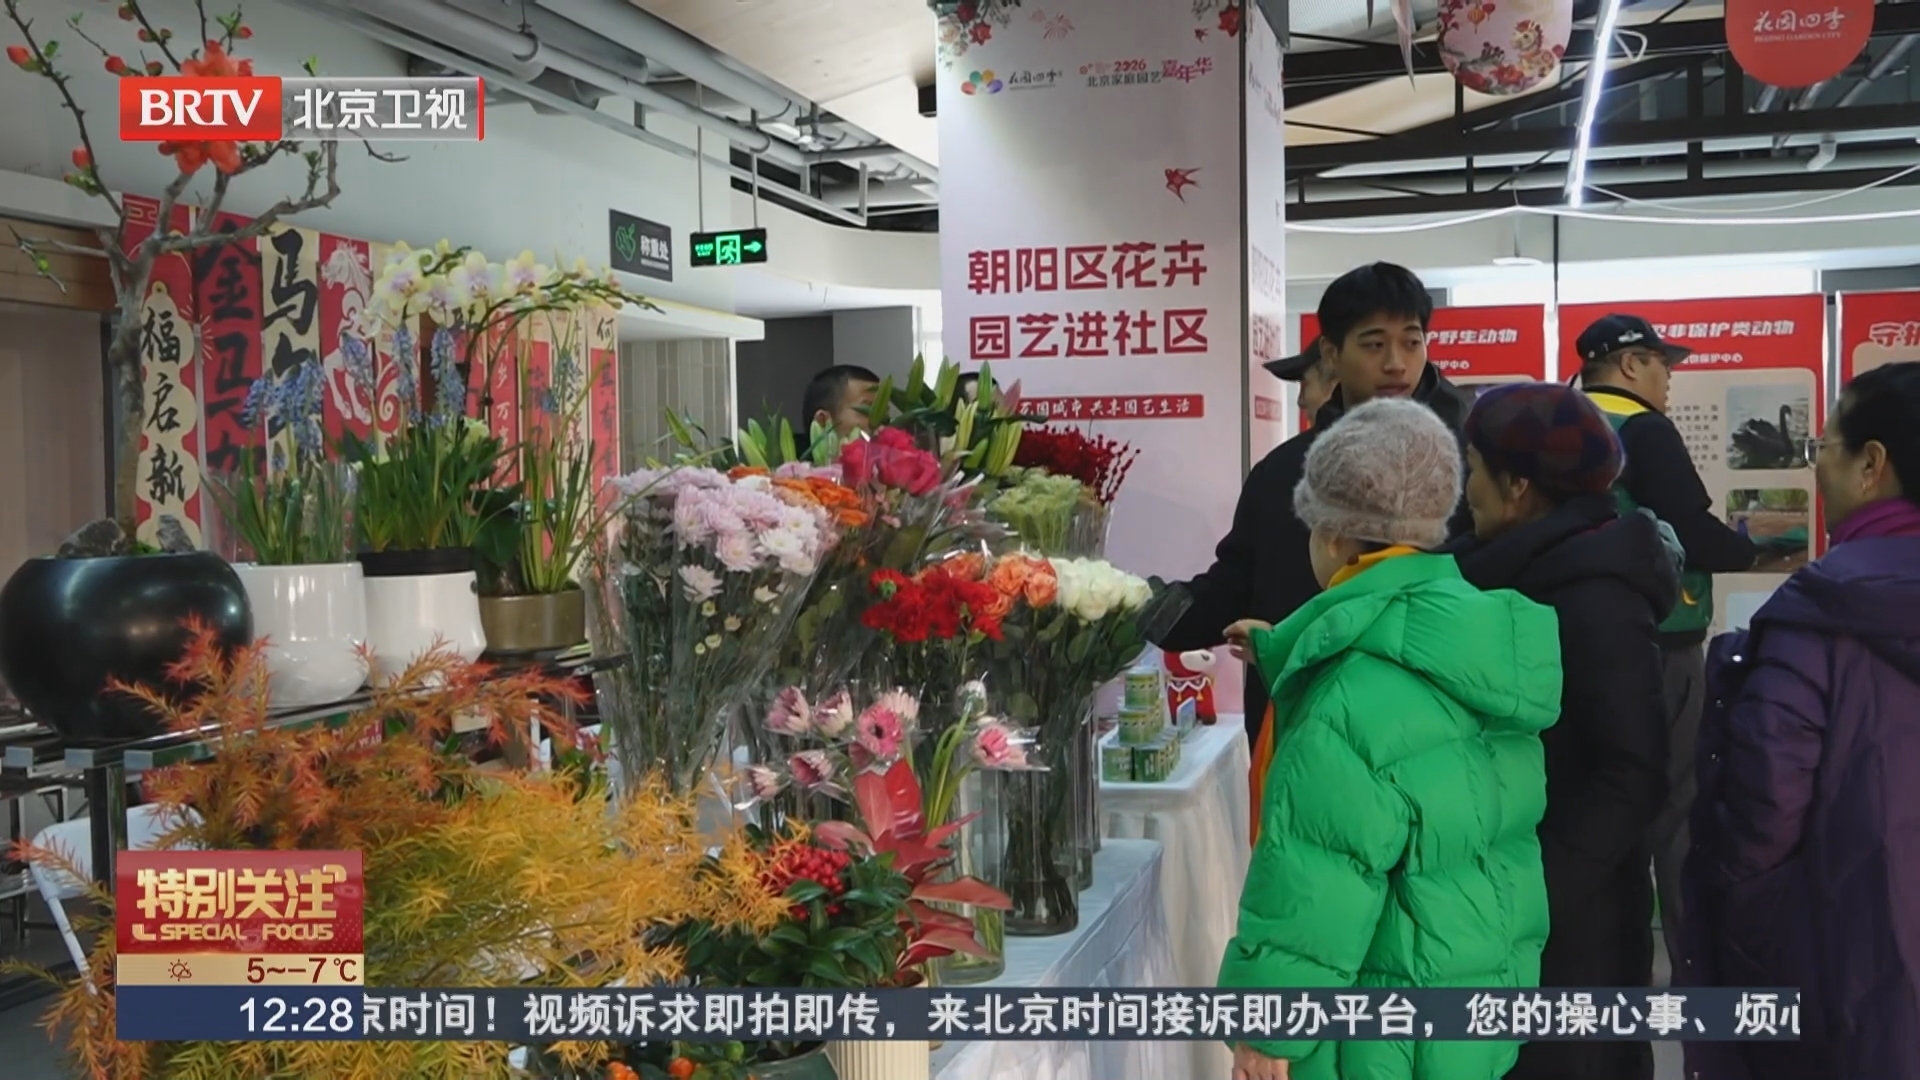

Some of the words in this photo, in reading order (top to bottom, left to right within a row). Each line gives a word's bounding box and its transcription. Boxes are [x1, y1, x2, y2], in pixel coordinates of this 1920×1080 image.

[1753, 7, 1845, 32] 花园四季
[1822, 31, 1841, 39] CITY
[1086, 70, 1162, 88] 北京家庭园艺
[1161, 57, 1213, 83] 嘉年华
[1114, 58, 1147, 73] 2026
[967, 238, 1208, 295] 朝阳区花卉
[969, 308, 1208, 360] 园艺进社区
[140, 306, 186, 505] 福启新
[1089, 398, 1191, 416] 共享园艺生活
